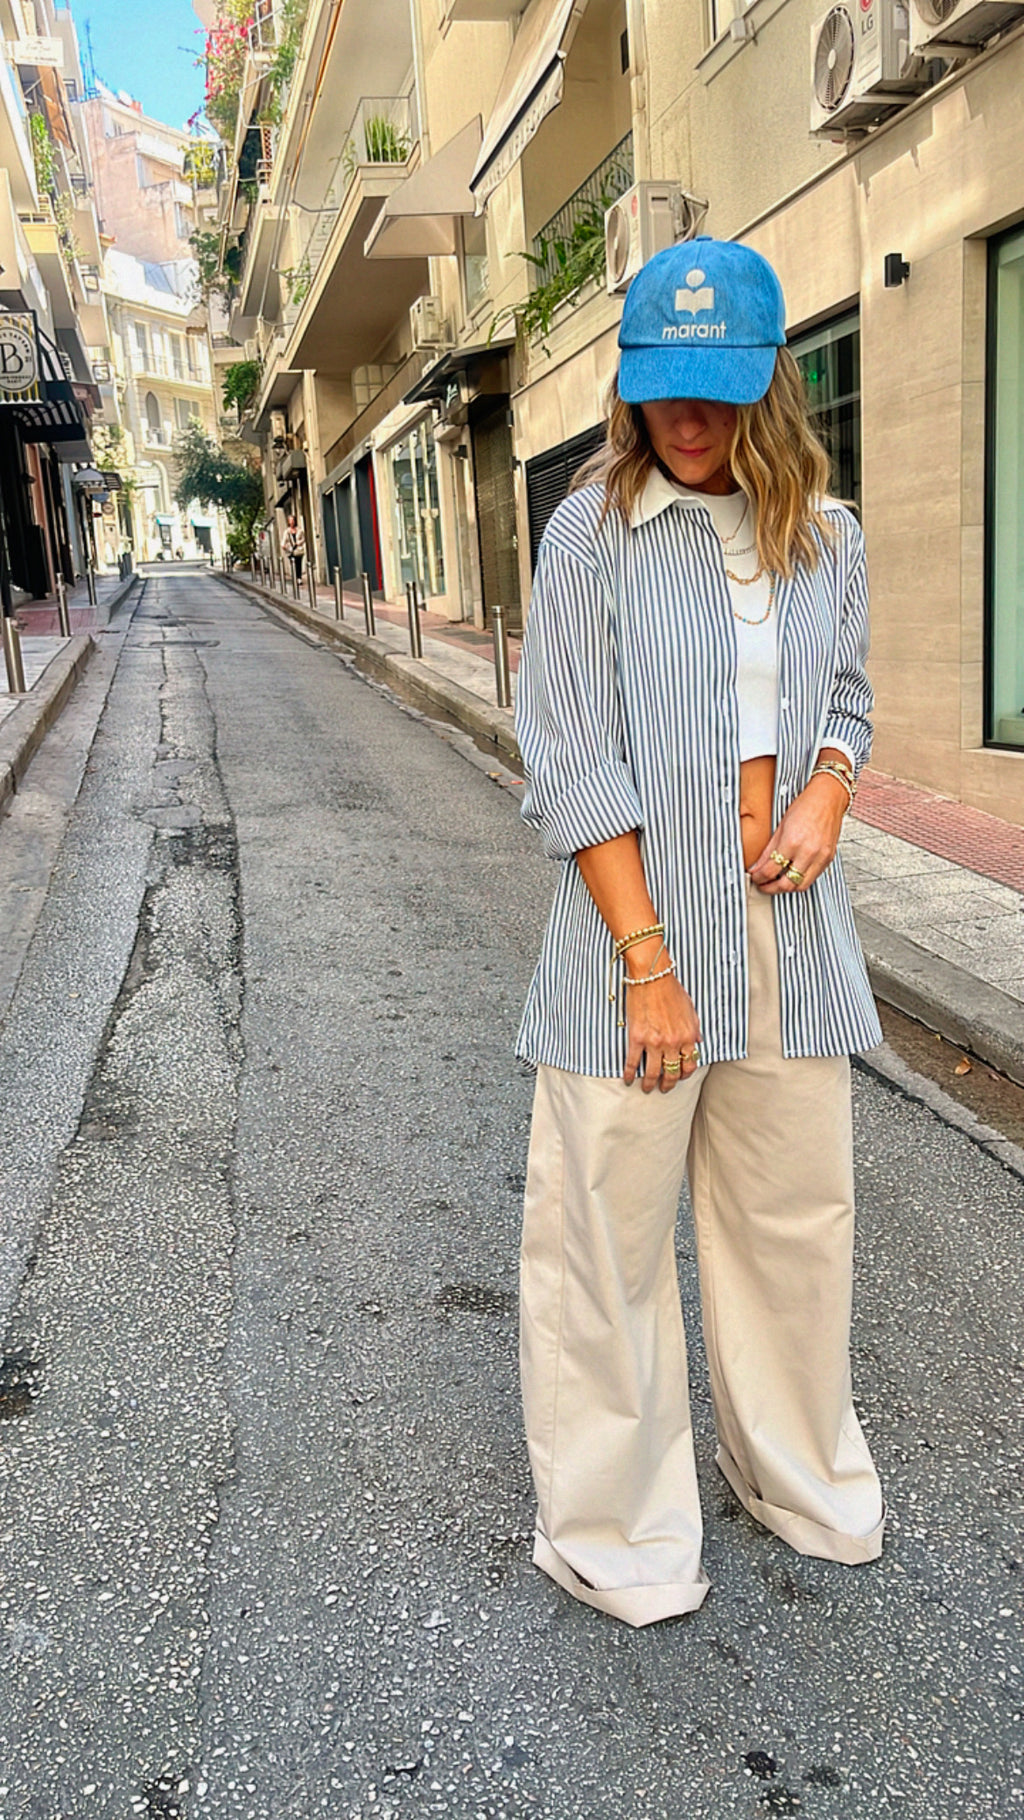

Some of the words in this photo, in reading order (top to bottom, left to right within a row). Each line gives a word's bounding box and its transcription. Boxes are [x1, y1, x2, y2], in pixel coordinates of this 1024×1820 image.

[861, 13, 874, 35] LG
[662, 320, 727, 340] marant
[0, 342, 24, 374] B
